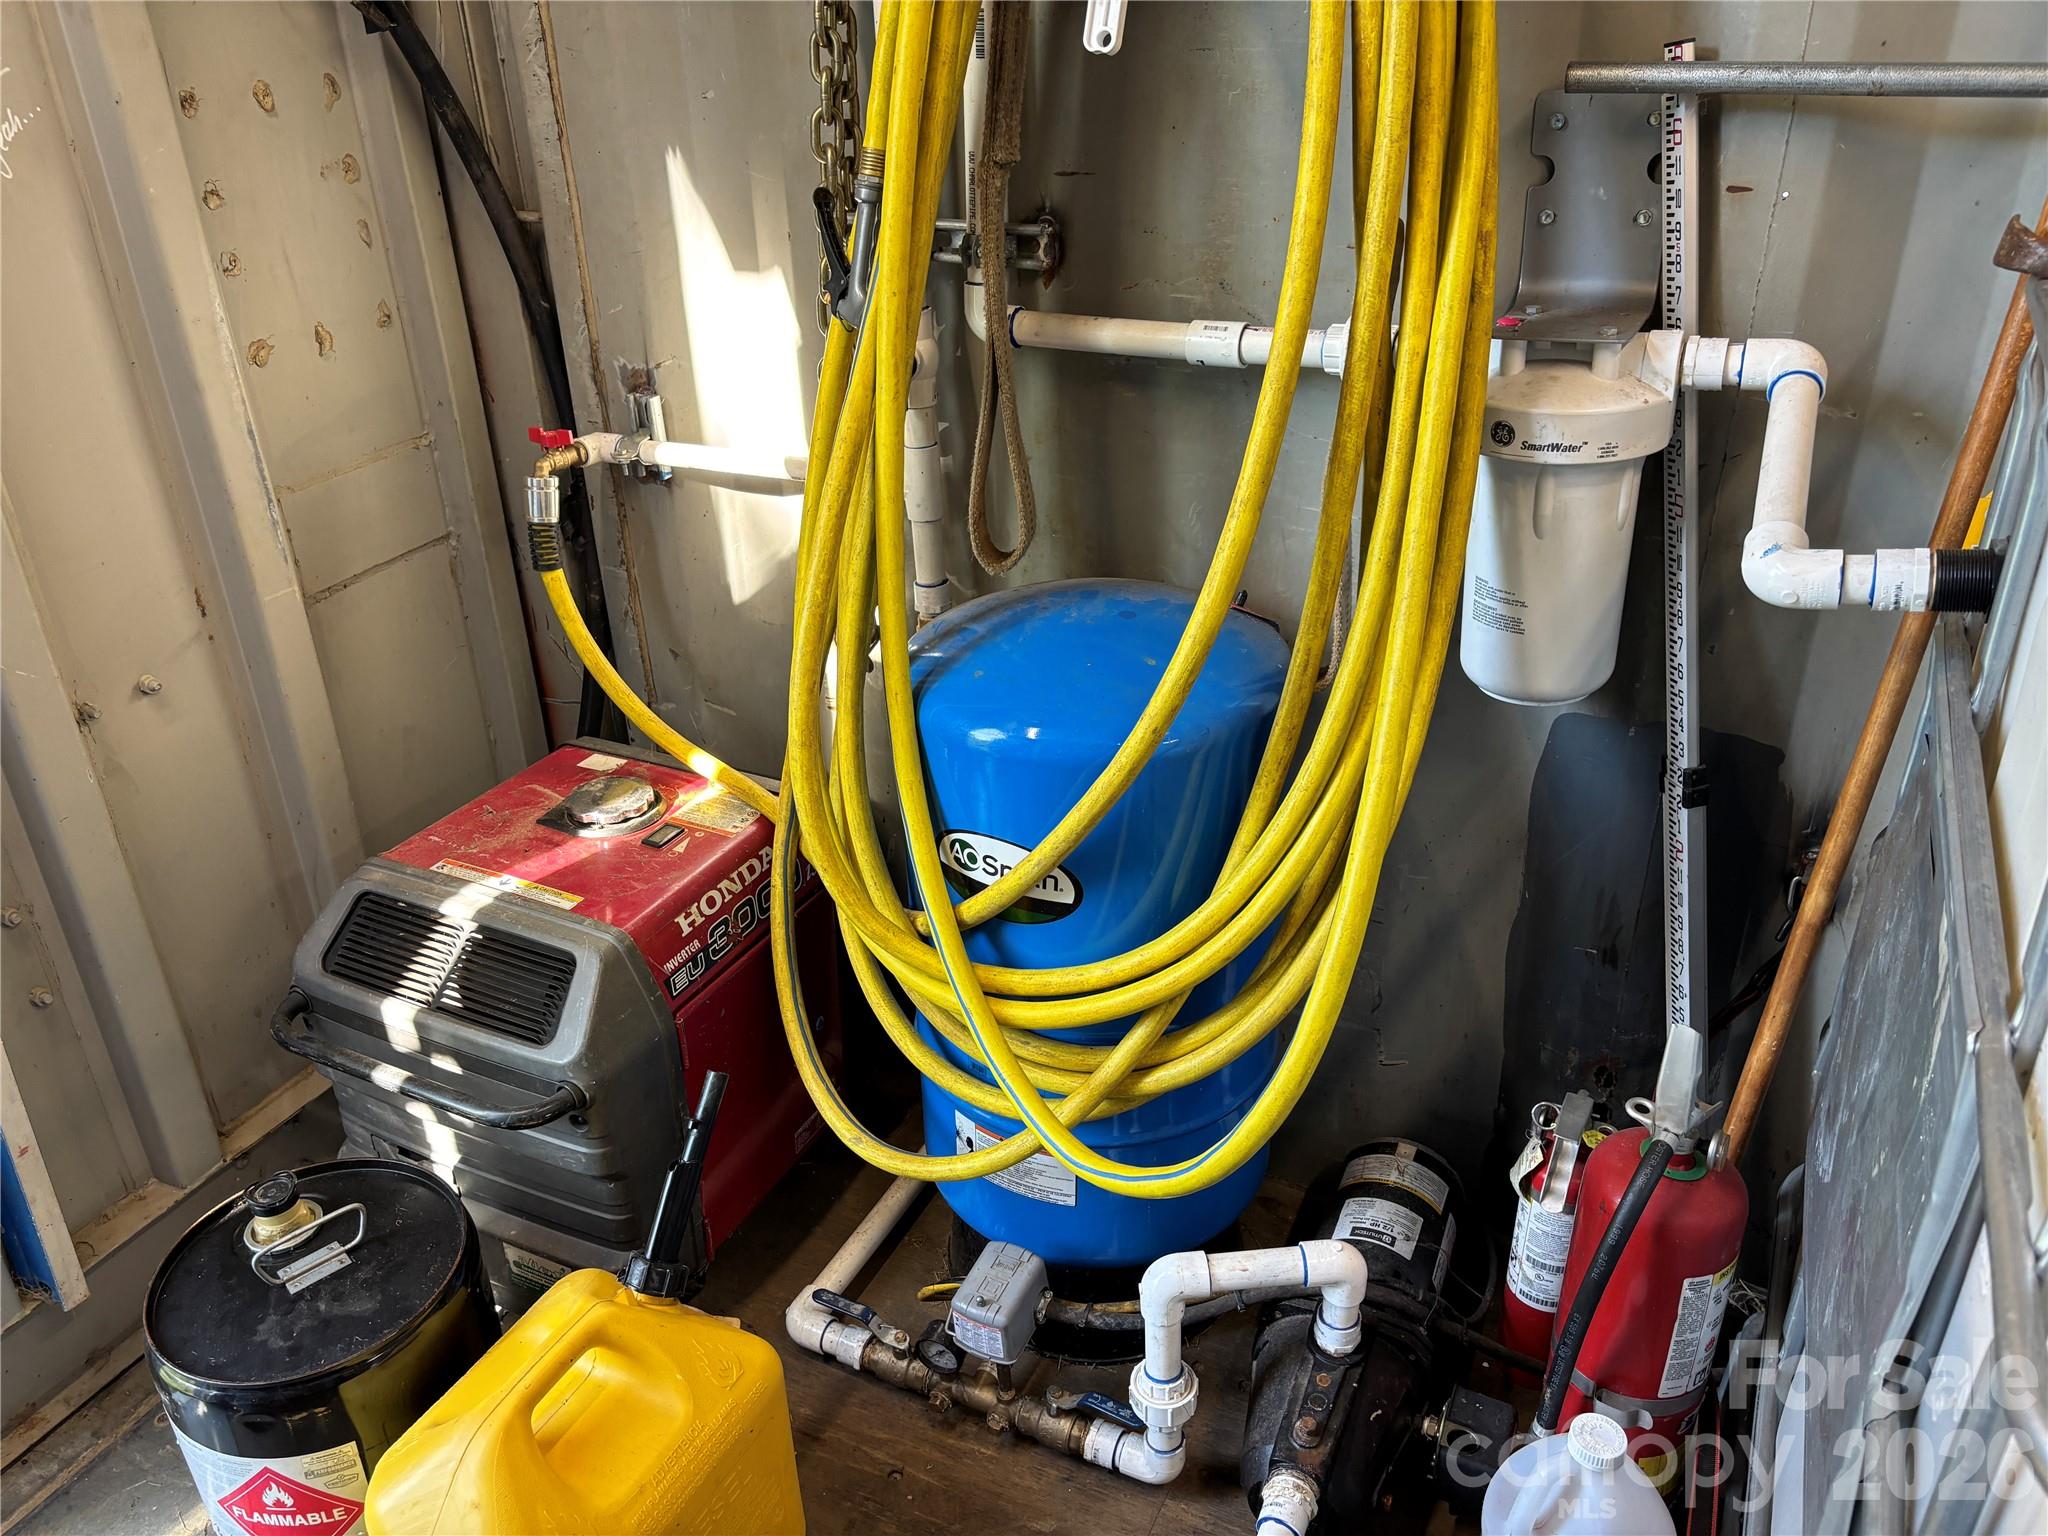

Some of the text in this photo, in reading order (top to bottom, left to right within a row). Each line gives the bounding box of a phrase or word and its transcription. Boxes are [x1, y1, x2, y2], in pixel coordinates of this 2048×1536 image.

[1675, 221, 1682, 242] 9
[1675, 254, 1682, 273] 8
[1675, 286, 1682, 305] 7
[674, 845, 774, 937] HONDA
[664, 939, 701, 973] INVERTER
[670, 953, 706, 997] EU
[1369, 1221, 1395, 1233] 1/2 HP
[231, 1506, 348, 1527] FLAMMABLE
